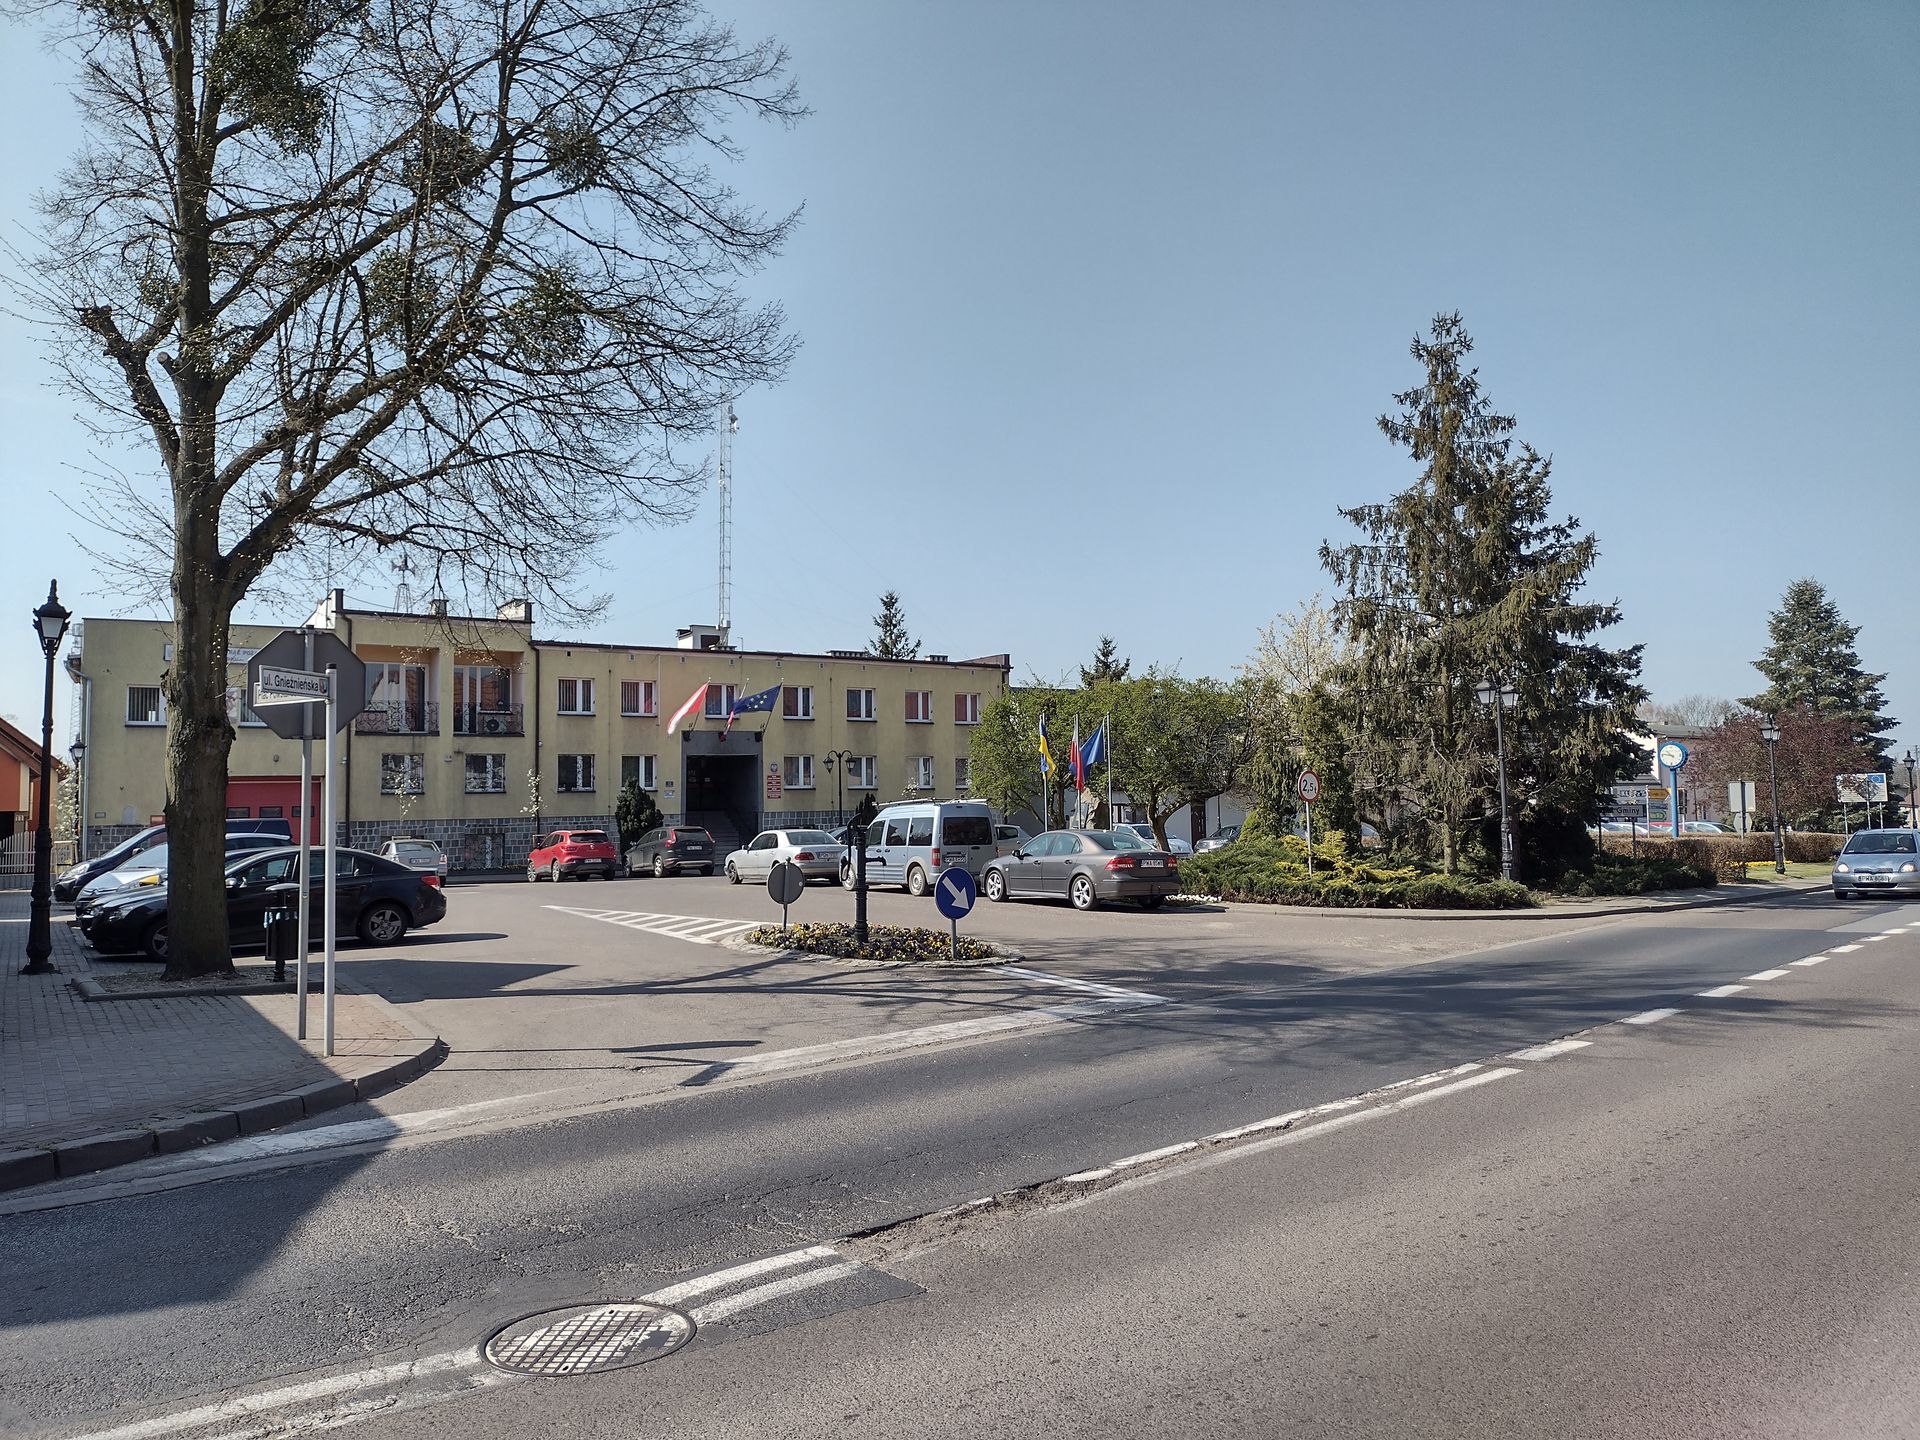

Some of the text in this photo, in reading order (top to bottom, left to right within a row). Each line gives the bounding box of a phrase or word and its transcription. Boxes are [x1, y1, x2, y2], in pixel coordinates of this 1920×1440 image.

[264, 673, 319, 692] ul. Gnieźnieńska
[1616, 806, 1640, 815] Gminy
